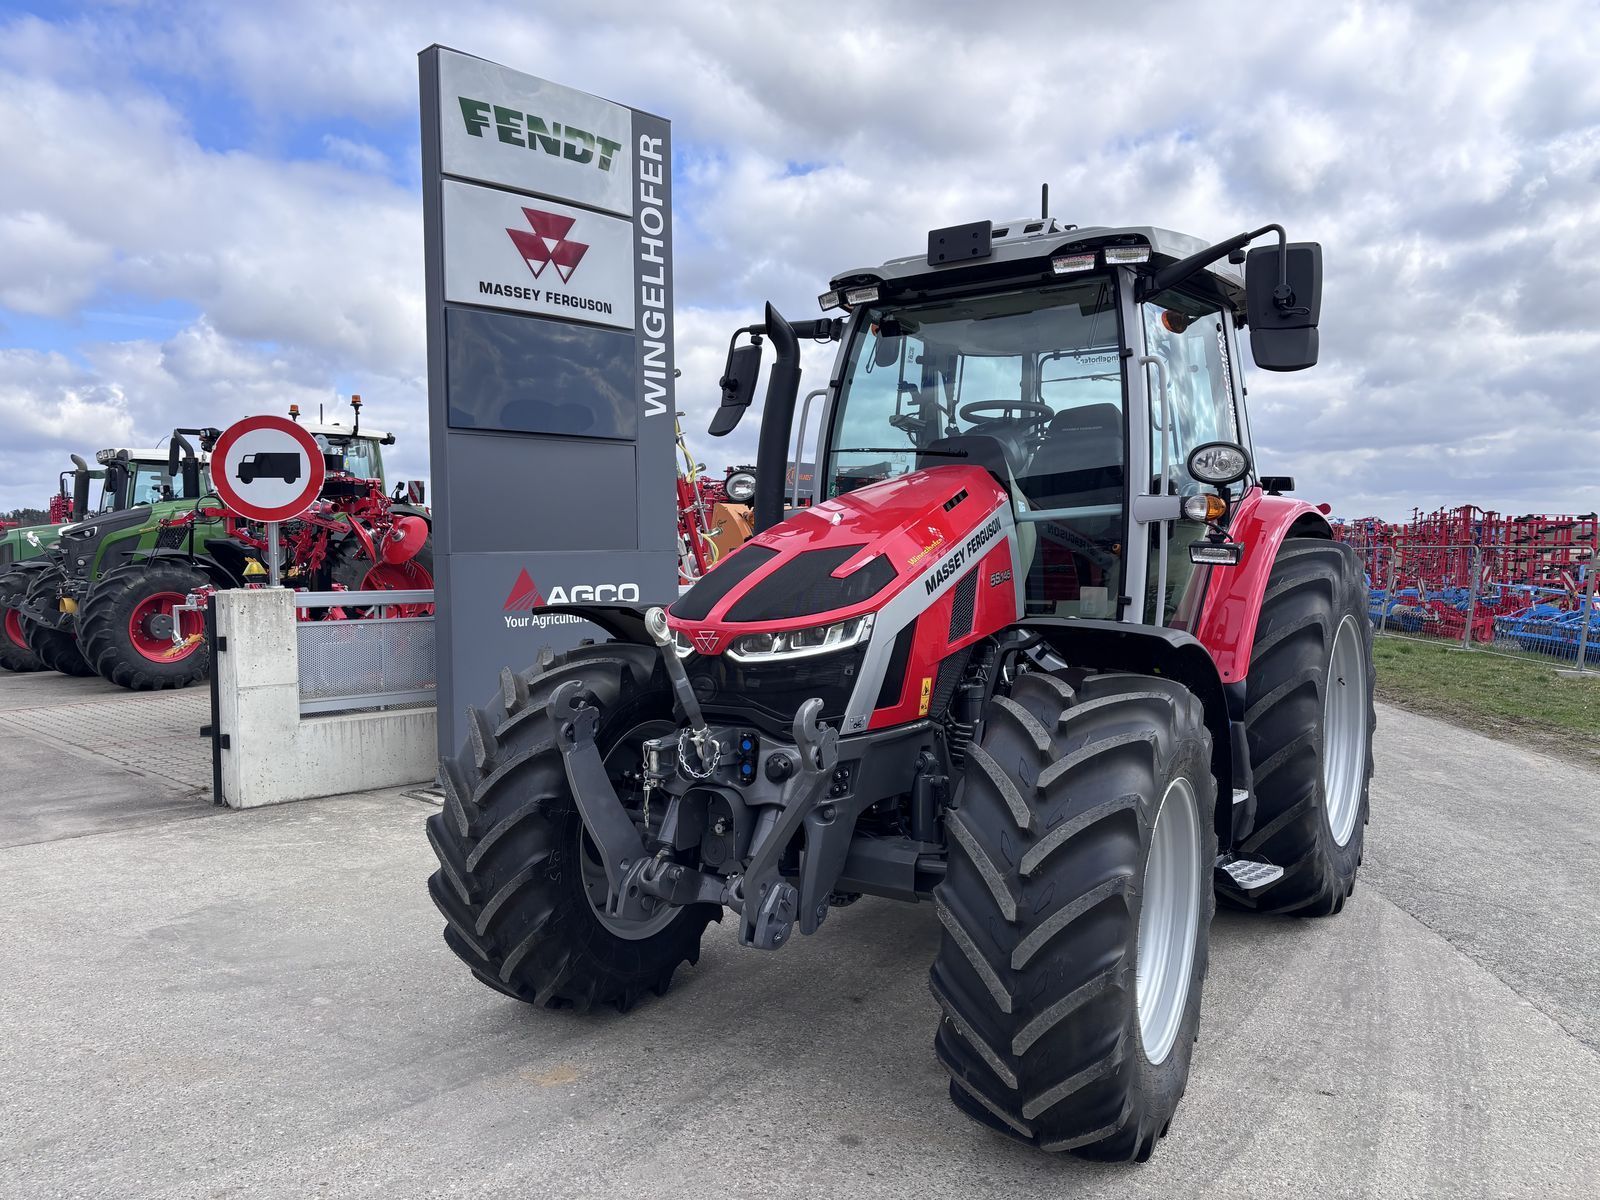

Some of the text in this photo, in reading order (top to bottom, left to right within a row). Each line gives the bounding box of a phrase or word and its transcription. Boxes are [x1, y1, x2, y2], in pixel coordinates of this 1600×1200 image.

[458, 96, 622, 171] FENDT
[479, 281, 612, 314] MASSEY FERGUSON
[639, 134, 667, 417] WINGELHOFER
[924, 516, 1002, 596] MASSEY FERGUSON
[547, 583, 640, 605] AGCO
[504, 616, 530, 628] Your
